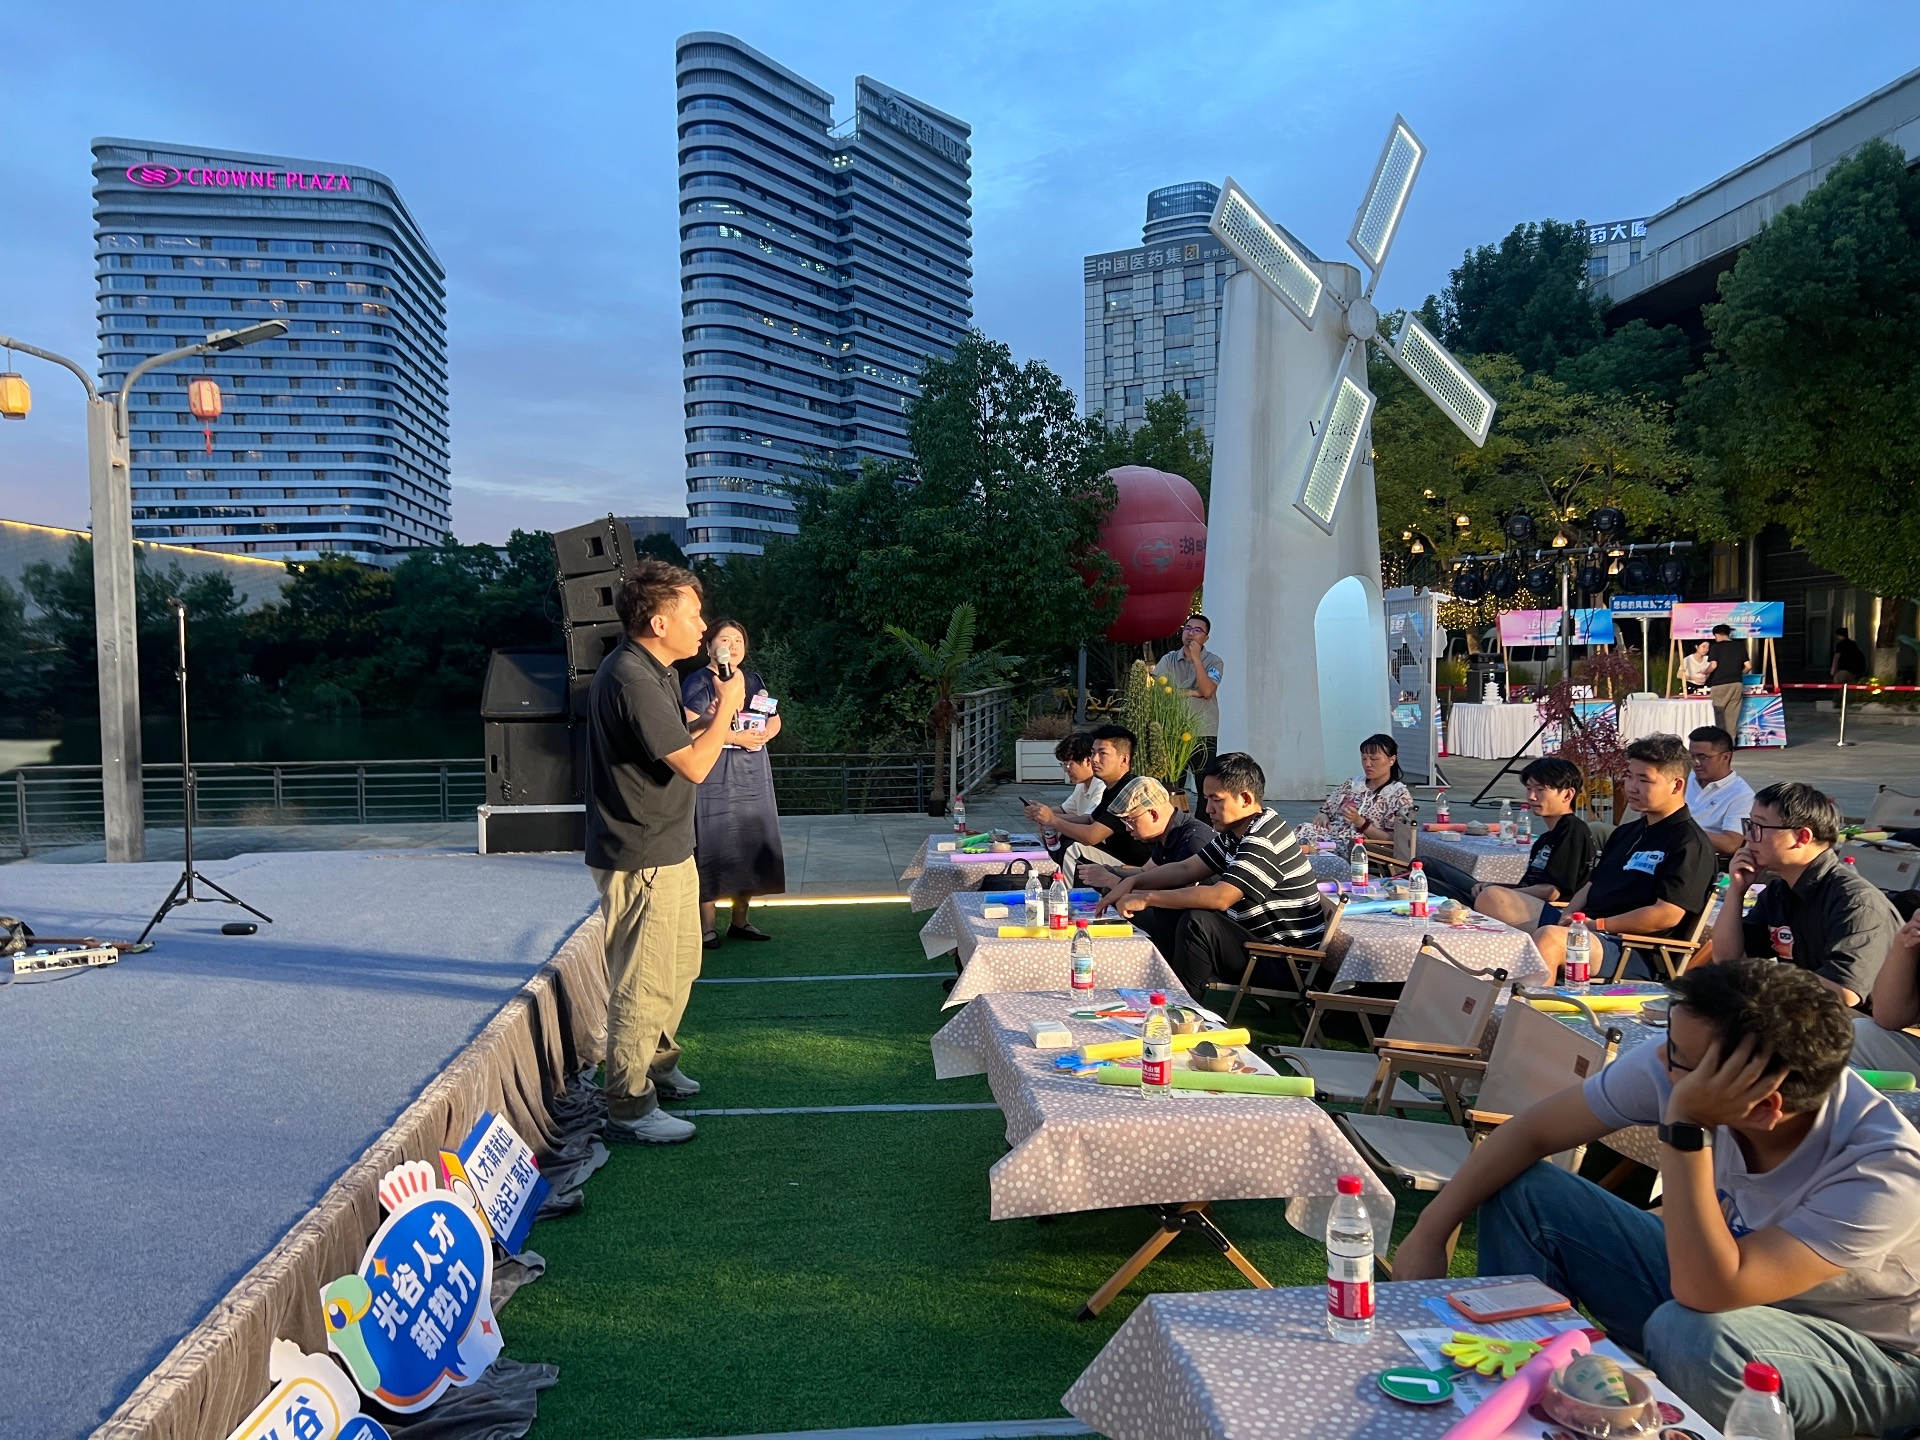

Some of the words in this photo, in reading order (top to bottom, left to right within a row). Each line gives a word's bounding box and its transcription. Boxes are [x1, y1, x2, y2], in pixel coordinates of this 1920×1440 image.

[187, 167, 277, 190] CROWNE
[287, 171, 351, 193] PLAZA
[1572, 220, 1647, 244] 药大厦
[1097, 243, 1200, 275] 中国医药集团
[469, 1126, 514, 1191] 人才请就位
[371, 1211, 455, 1341] 光谷人才
[409, 1258, 477, 1361] 新势力
[257, 1395, 325, 1440] 谷
